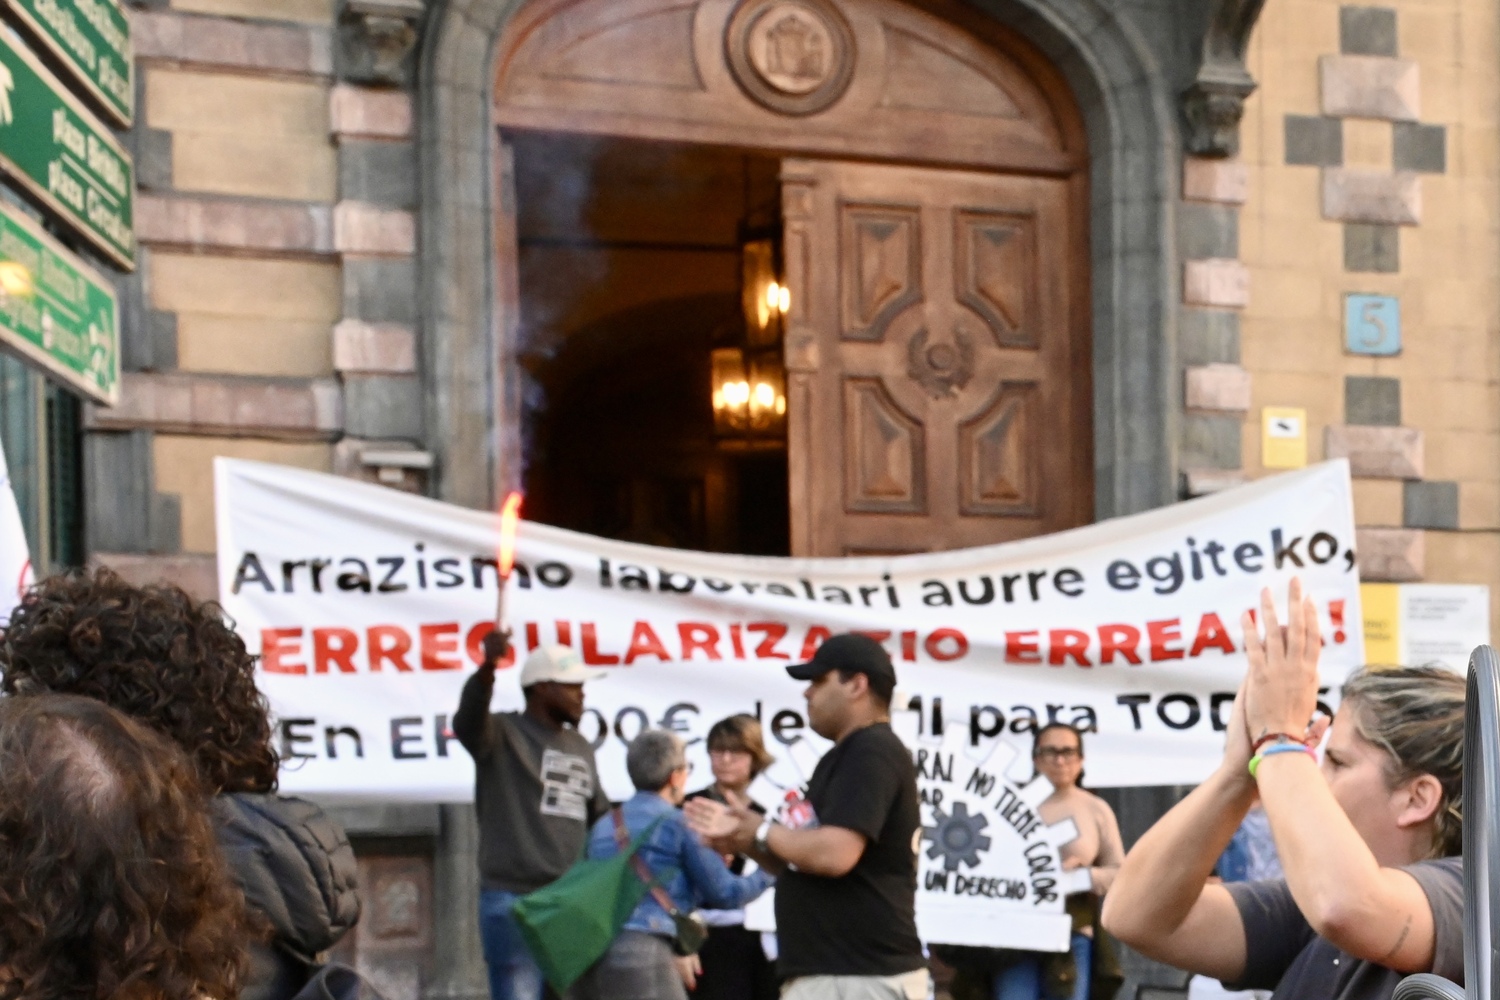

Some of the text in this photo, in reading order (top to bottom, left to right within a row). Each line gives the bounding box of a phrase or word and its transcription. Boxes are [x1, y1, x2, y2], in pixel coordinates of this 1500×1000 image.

[1359, 302, 1387, 347] 5
[232, 542, 573, 595] Arrazismo
[922, 566, 1085, 607] aurre
[1106, 527, 1356, 595] egiteko,
[1004, 598, 1346, 667] ERREA!
[279, 717, 365, 759] En
[970, 700, 1097, 746] para
[965, 766, 995, 798] NO
[994, 786, 1042, 840] TIENE
[1024, 841, 1058, 905] COLOR
[925, 870, 1027, 900] UN DERECHO
